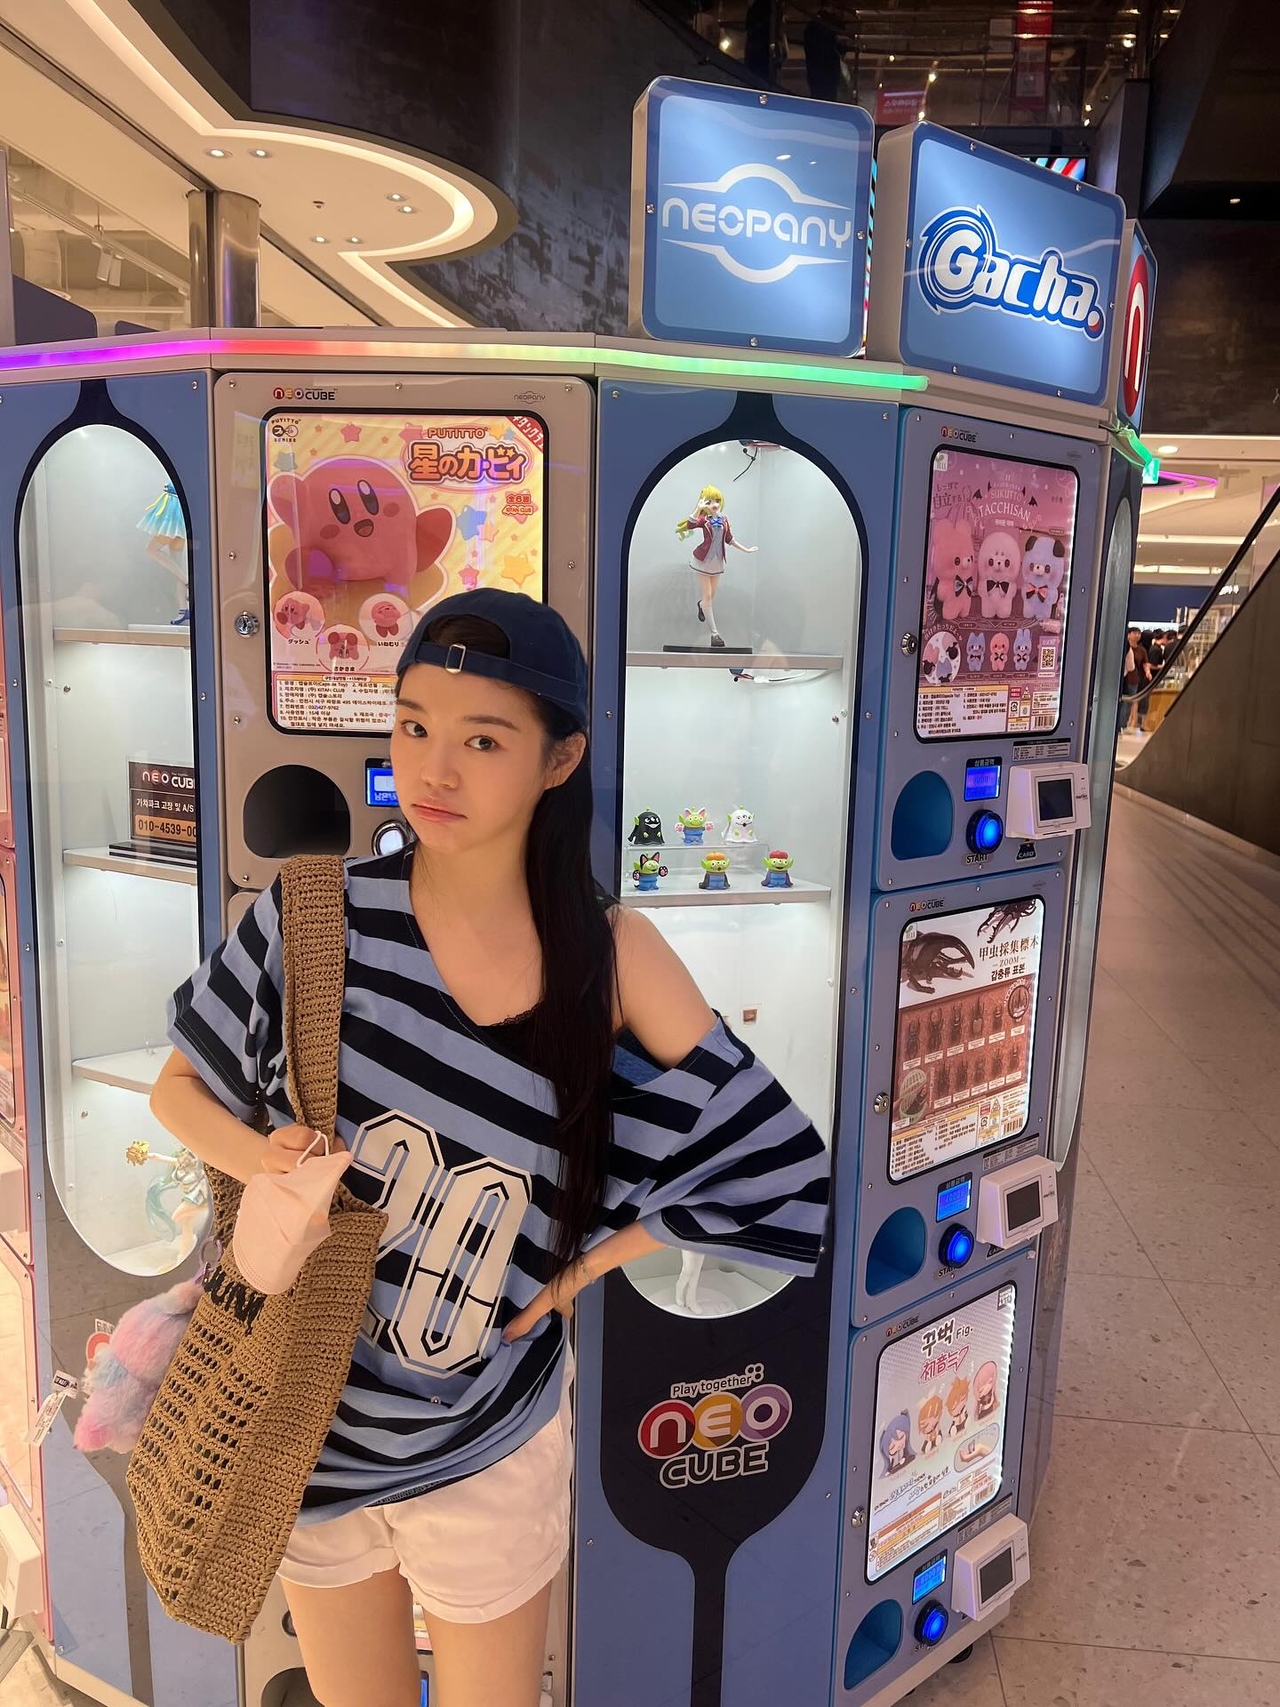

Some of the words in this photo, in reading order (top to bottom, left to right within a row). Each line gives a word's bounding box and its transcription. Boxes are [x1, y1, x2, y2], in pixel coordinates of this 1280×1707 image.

[305, 391, 336, 401] CUBE
[427, 427, 486, 439] PUTITTO
[959, 432, 977, 443] CUBE
[978, 501, 1032, 522] TACCHISAN
[171, 776, 195, 789] CUB
[161, 801, 173, 811] 고장
[175, 803, 181, 812] 및
[182, 804, 195, 813] A/S
[928, 899, 944, 910] CUBE
[1012, 963, 1026, 975] 표본
[903, 1315, 919, 1329] CUBE
[922, 1319, 955, 1358] 꾸벅
[956, 1324, 974, 1341] Fig.
[672, 1383, 699, 1397] Play
[701, 1374, 753, 1393] together
[660, 1441, 769, 1489] CUBE
